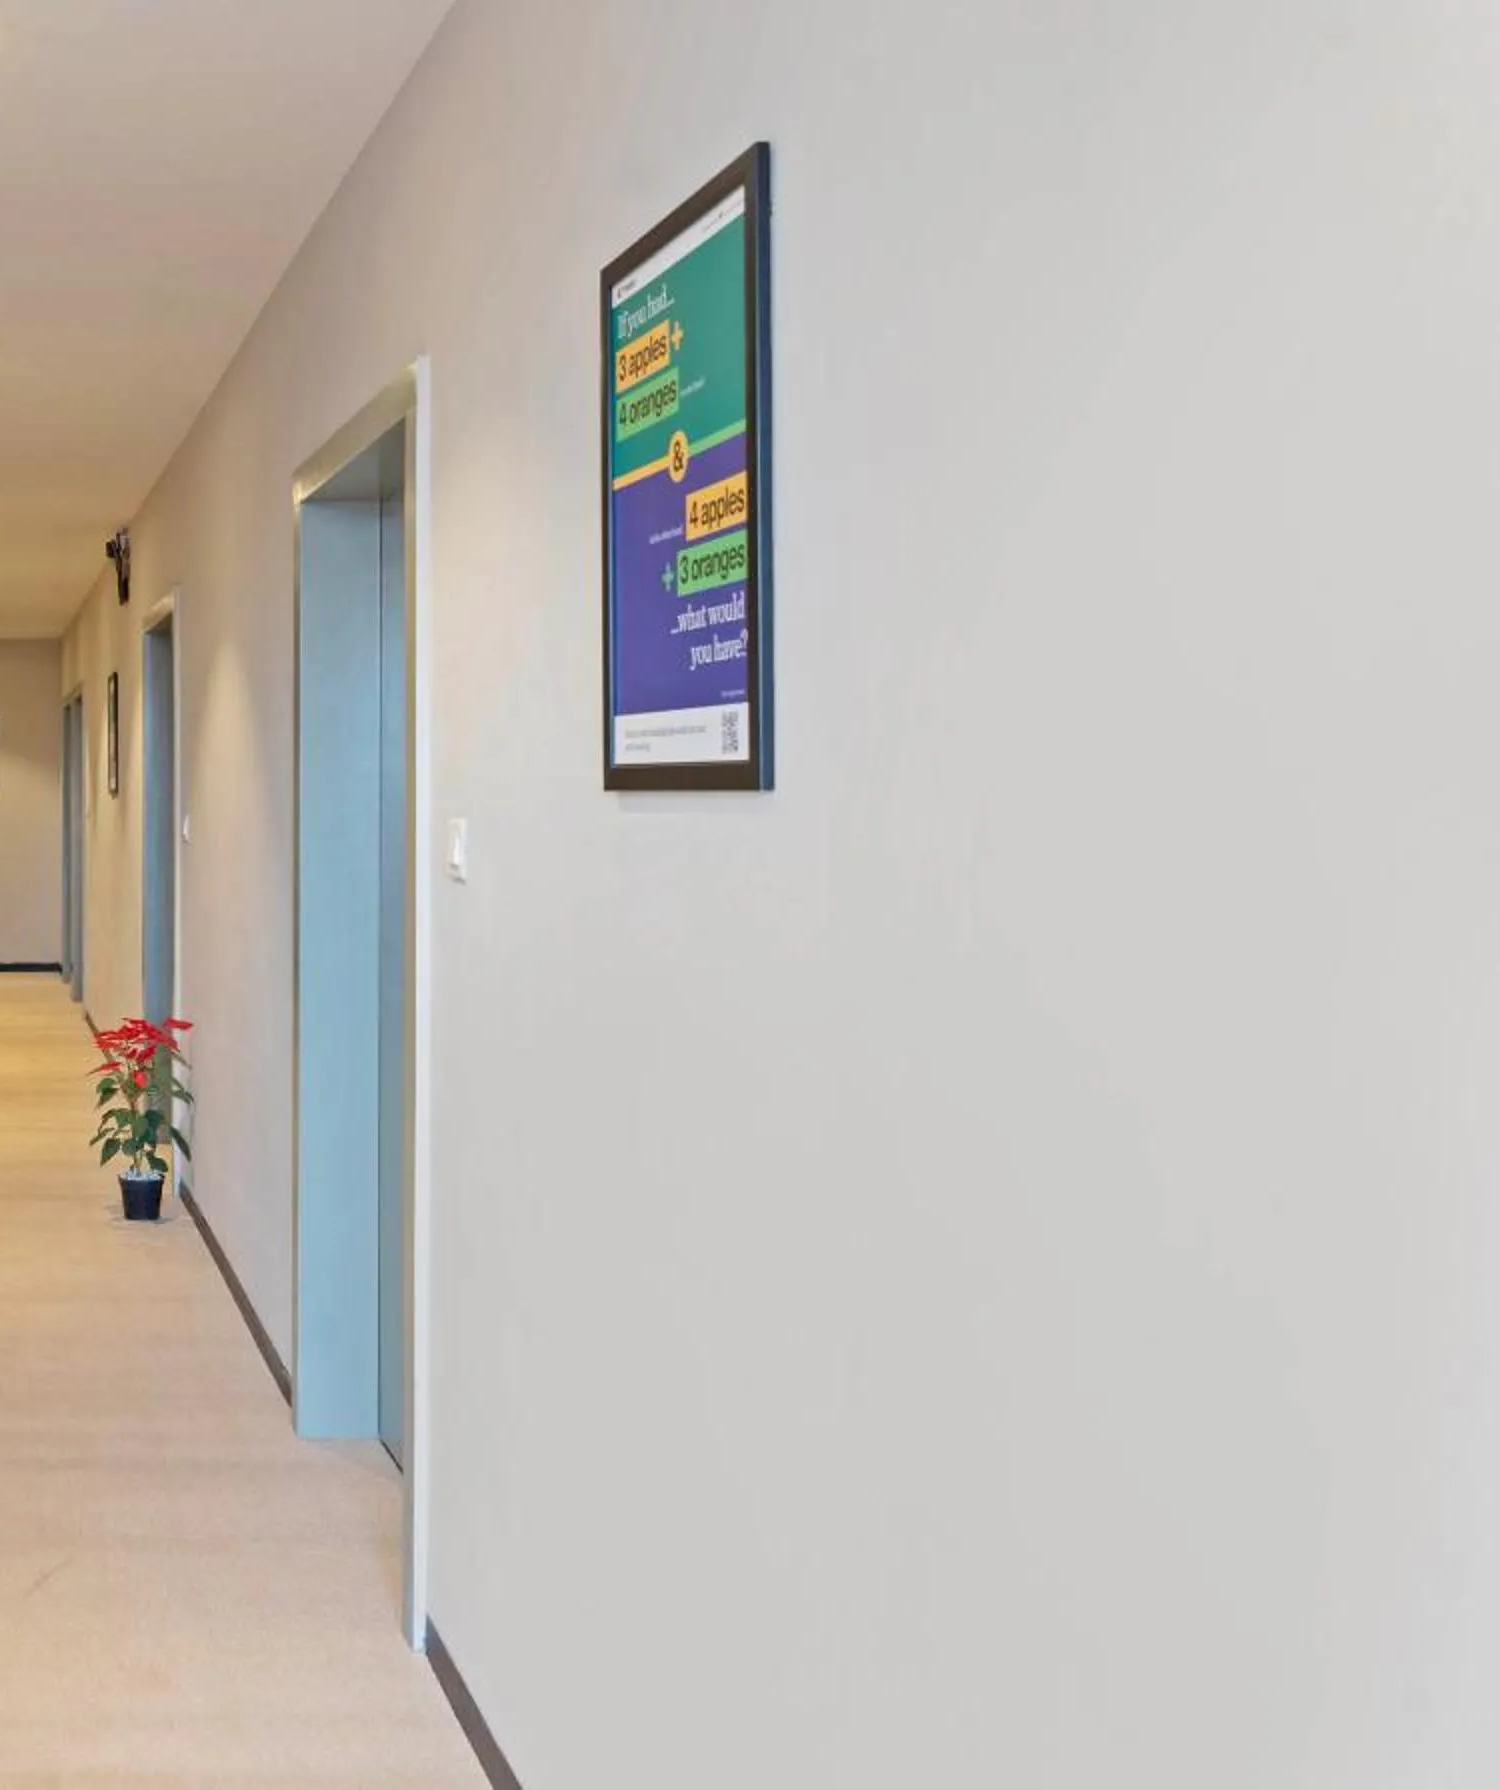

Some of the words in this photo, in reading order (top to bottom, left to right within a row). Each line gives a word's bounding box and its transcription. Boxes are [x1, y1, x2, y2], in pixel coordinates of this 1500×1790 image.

[618, 311, 628, 338] If
[627, 306, 647, 338] you
[619, 354, 627, 381] 3
[629, 336, 667, 378] apples
[671, 321, 684, 351] +
[619, 401, 627, 426] 4
[629, 380, 677, 423] oranges
[673, 440, 684, 472] &
[689, 502, 698, 528] 4
[701, 485, 745, 529] apples
[662, 562, 675, 592] +
[680, 555, 689, 585] 3
[691, 544, 745, 579] oranges
[709, 591, 745, 625] would
[689, 643, 712, 671] you
[714, 628, 748, 661] have?
